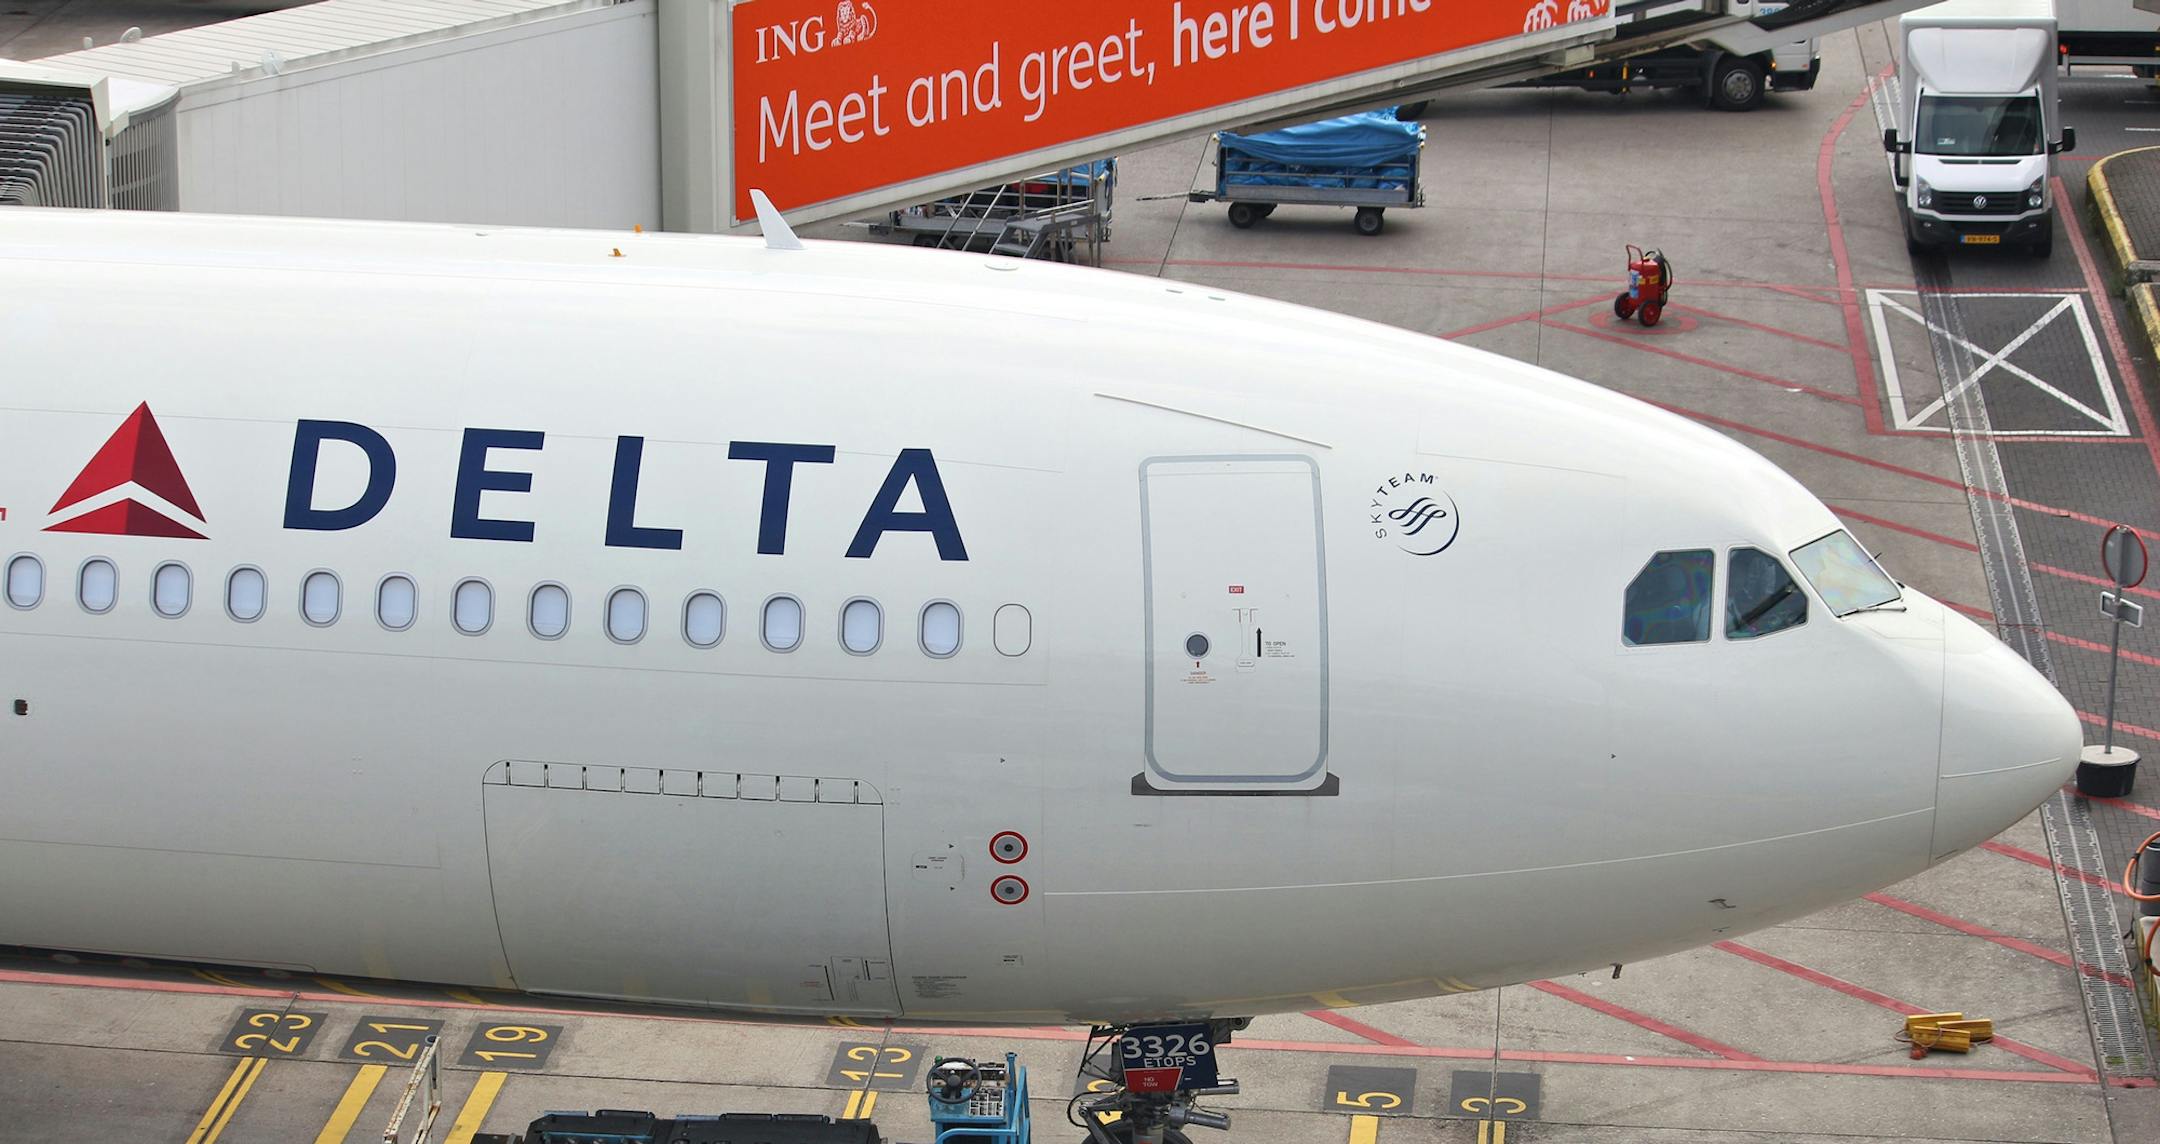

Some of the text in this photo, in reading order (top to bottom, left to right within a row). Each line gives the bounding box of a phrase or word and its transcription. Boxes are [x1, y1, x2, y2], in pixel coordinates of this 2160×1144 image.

[756, 16, 826, 64] ING
[758, 74, 890, 164] Meet
[906, 41, 1002, 127] and
[1019, 18, 1155, 122] greet,
[1173, 1, 1274, 68] here
[1313, 0, 1432, 33] co
[283, 419, 969, 561] DELTA
[1370, 472, 1434, 539] SKYTEAM
[235, 1013, 312, 1052] 23
[353, 1023, 431, 1060] 21
[474, 1026, 549, 1062] 19
[1121, 1033, 1210, 1059] 3326
[839, 1046, 913, 1081] 13
[1143, 1055, 1196, 1068] ETOPS
[1336, 1091, 1402, 1109] 5
